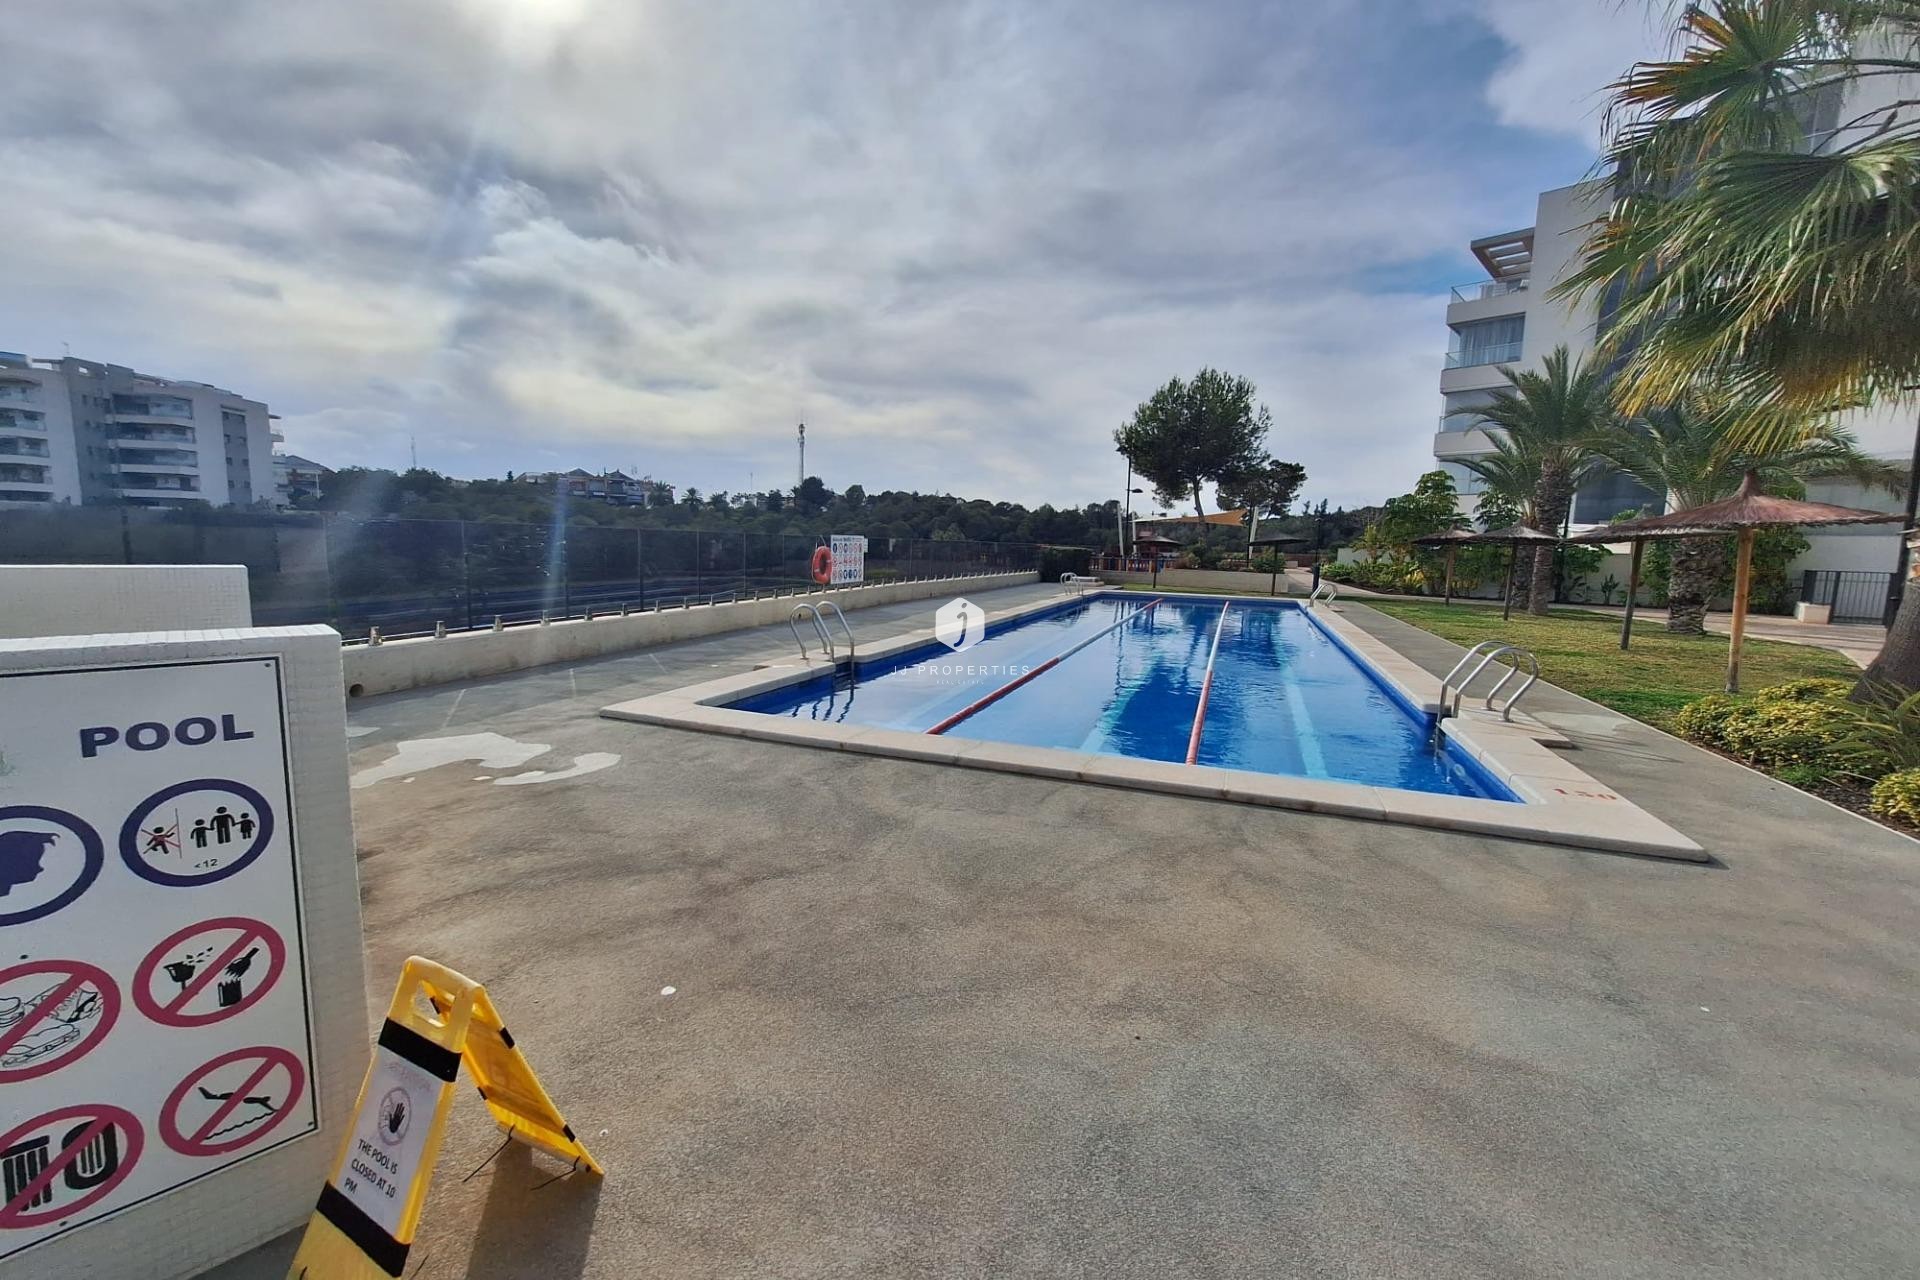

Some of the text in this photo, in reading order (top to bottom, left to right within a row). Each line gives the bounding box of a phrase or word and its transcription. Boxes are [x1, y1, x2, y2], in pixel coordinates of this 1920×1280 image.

[80, 713, 255, 758] POOL
[358, 1138, 398, 1175] THE POOL IS
[344, 1177, 358, 1195] PM
[351, 1158, 396, 1198] CLOSED AT 10
